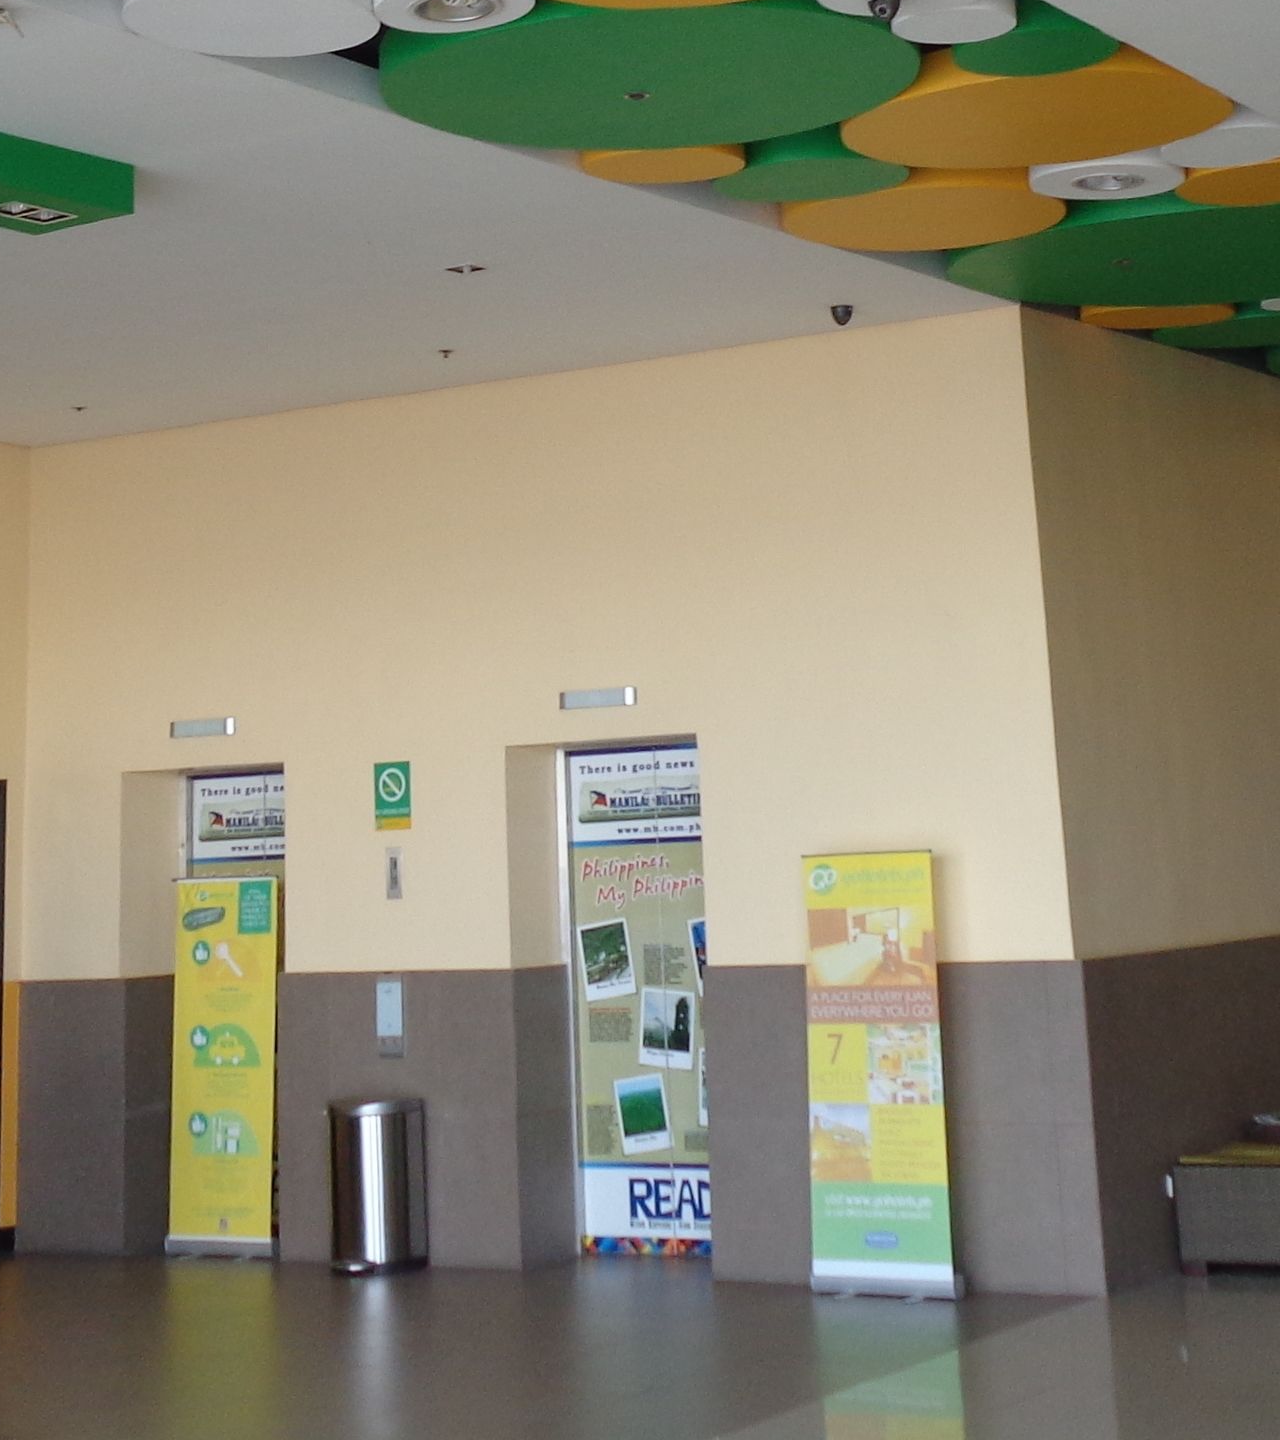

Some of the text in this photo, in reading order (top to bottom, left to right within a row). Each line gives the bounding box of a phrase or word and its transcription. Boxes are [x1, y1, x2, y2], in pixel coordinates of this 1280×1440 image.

[579, 759, 695, 775] There is good news
[201, 787, 228, 797] There
[232, 786, 241, 795] is
[245, 784, 268, 796] good
[609, 795, 646, 809] MANILA
[264, 815, 284, 826] BULL
[231, 844, 284, 852] www.mb.com
[596, 872, 703, 910] My Philippin
[811, 992, 818, 1002] A
[819, 992, 848, 1002] PLACE
[851, 992, 872, 1002] FOR
[874, 992, 903, 1002] EVERY
[811, 1005, 883, 1017] EVERYWHERE
[884, 1005, 909, 1017] YOU
[827, 1033, 844, 1065] 7
